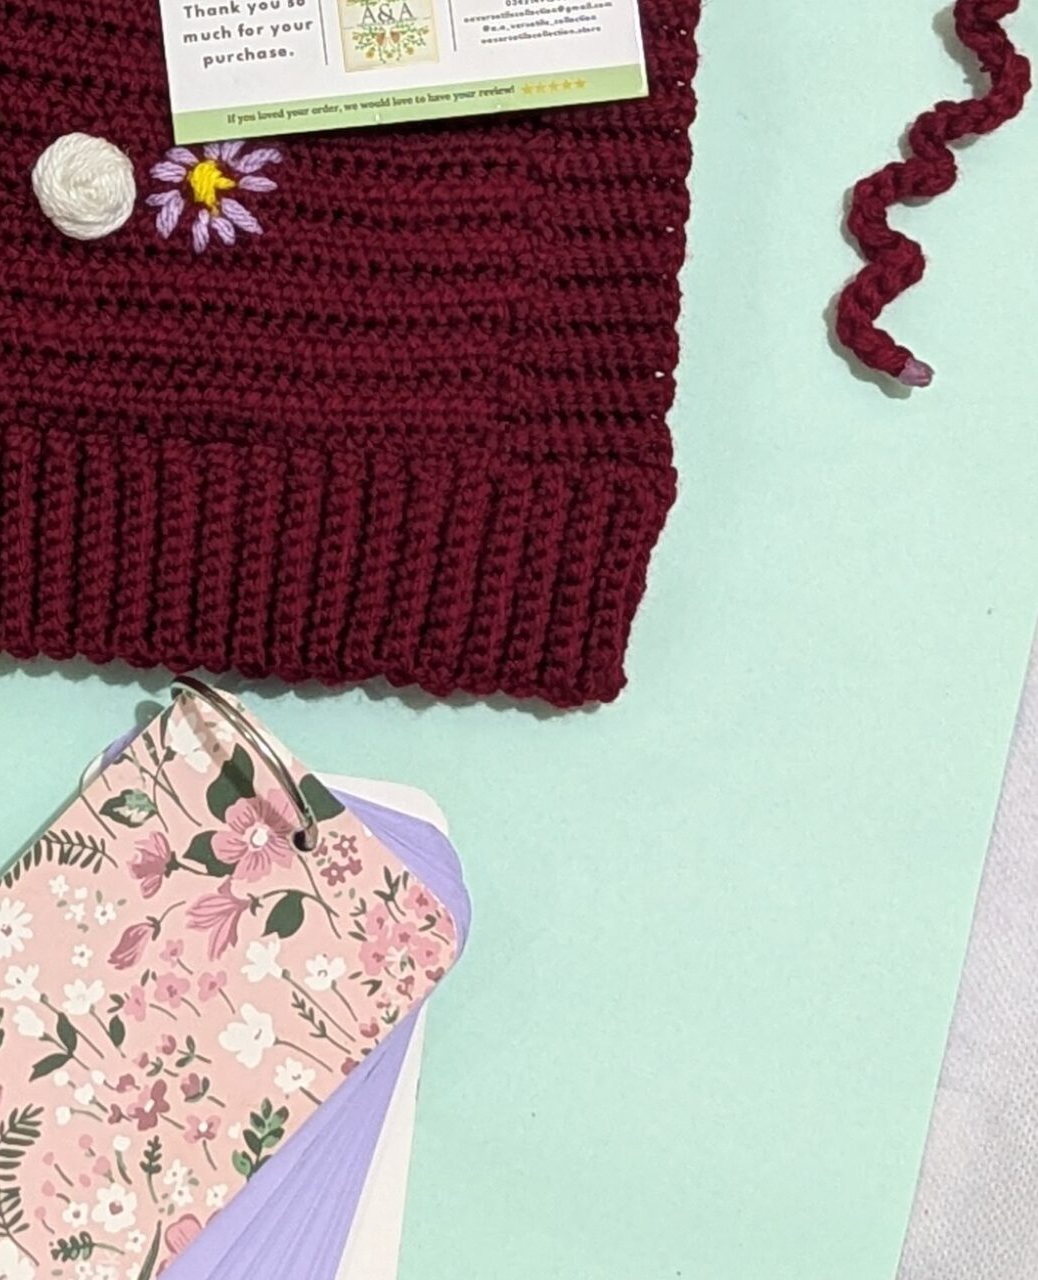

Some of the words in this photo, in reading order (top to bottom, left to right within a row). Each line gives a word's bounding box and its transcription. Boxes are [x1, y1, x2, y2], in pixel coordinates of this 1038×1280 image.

[183, 0, 241, 19] Thank
[246, 0, 281, 16] you
[361, 1, 414, 27] A&A
[182, 24, 232, 43] much
[237, 23, 265, 38] for
[270, 19, 314, 37] your
[202, 45, 295, 69] purchase.
[227, 113, 236, 124] If
[237, 113, 256, 126] you
[258, 108, 285, 121] loved
[286, 107, 310, 120] your
[311, 104, 343, 115] order,
[344, 102, 358, 111] we
[360, 97, 391, 109] would
[392, 95, 413, 107] love
[415, 95, 427, 104] to
[427, 92, 452, 103] have
[453, 90, 476, 102] your
[478, 84, 515, 98] review!
